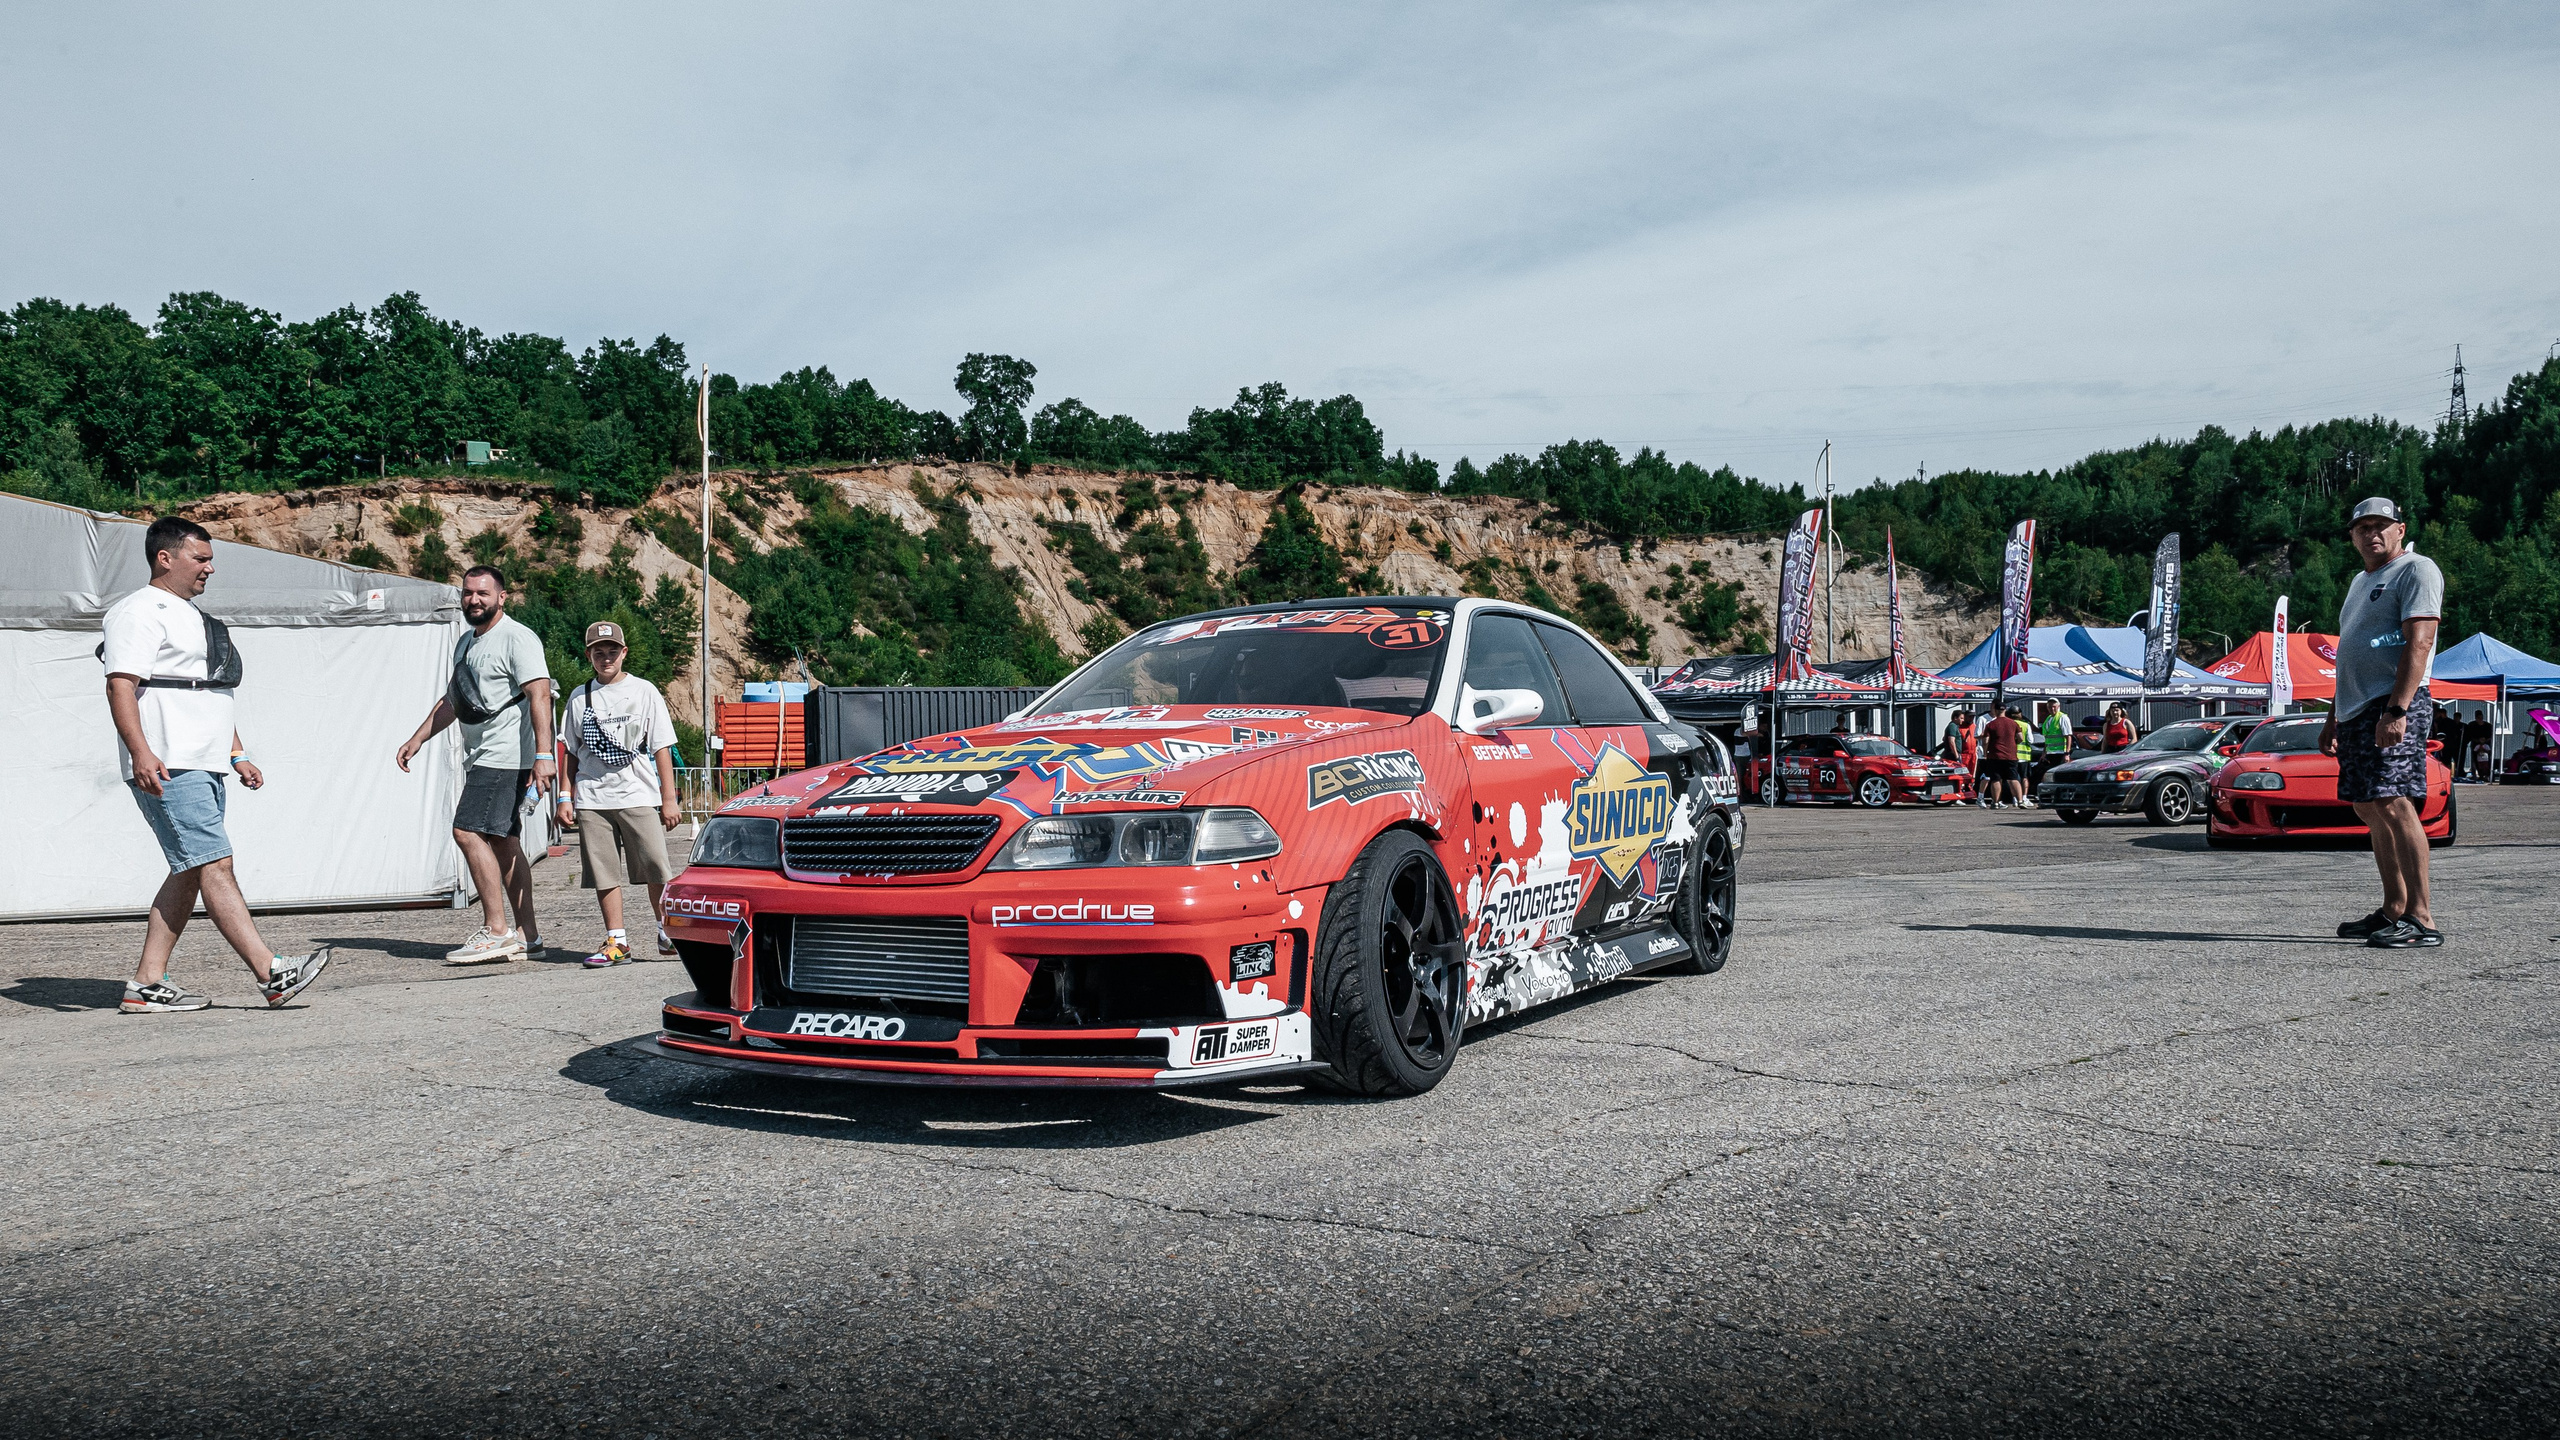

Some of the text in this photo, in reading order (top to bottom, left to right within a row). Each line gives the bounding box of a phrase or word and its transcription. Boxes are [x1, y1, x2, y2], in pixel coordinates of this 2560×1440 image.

[2162, 562, 2175, 651] ТИТАНКЛАВ
[1381, 622, 1430, 646] 31
[2106, 685, 2143, 696] ШИННЫЙ
[1208, 708, 1307, 717] HOLINGER
[1471, 744, 1512, 760] ВЕГЕРЯ
[833, 774, 960, 796] PROVODA
[1820, 770, 1836, 783] FQ
[1349, 783, 1381, 799] CUSTOM
[1574, 785, 1667, 846] SUNOCO
[664, 895, 740, 917] prodrive
[992, 898, 1155, 928] prodrive
[1497, 878, 1580, 926] PROGRESS
[1604, 901, 1634, 923] HPS
[1648, 937, 1680, 955] Achilles
[786, 1012, 906, 1041] RECARO
[1236, 1025, 1268, 1040] SUPER
[1195, 1026, 1229, 1061] ATI
[1229, 1038, 1271, 1054] DAMPER
